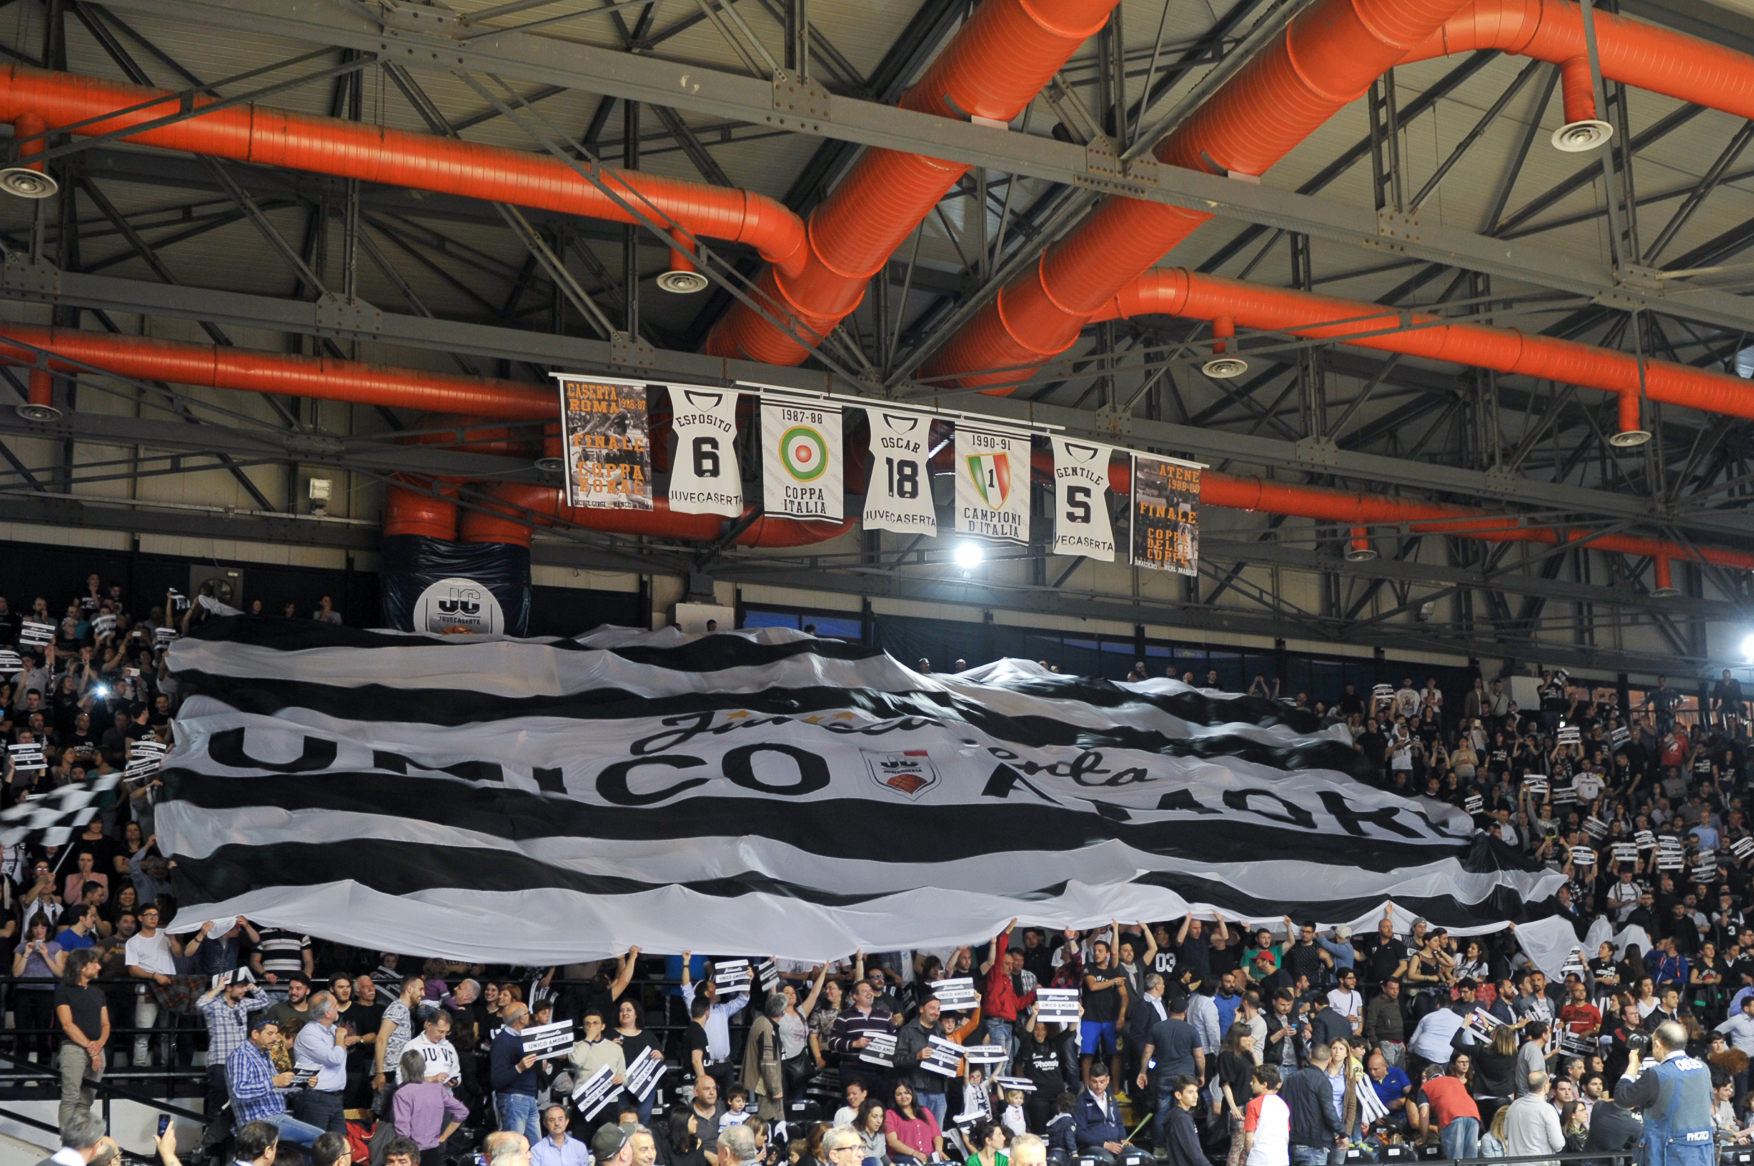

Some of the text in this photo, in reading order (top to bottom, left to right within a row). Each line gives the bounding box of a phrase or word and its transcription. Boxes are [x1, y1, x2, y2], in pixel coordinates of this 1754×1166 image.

[567, 383, 618, 400] CASERTA
[569, 399, 619, 414] ROMA
[675, 414, 732, 433] ESPOSITO
[781, 408, 823, 425] 1987-88
[573, 433, 645, 452] FINALE
[881, 437, 921, 453] OSCAR
[971, 434, 1011, 451] 1990-91
[692, 436, 720, 479] 6
[578, 461, 645, 480] COPPA
[885, 456, 919, 499] 18
[987, 468, 995, 489] 1
[1056, 466, 1104, 486] GENTILE
[1159, 464, 1200, 483] ATENE
[579, 477, 645, 496] KORAC
[785, 485, 824, 501] COPPA
[783, 499, 827, 515] ITALIA
[1066, 485, 1092, 524] 5
[1139, 501, 1197, 525] FINALE
[863, 509, 937, 528] JUVECASERTA
[964, 507, 1022, 526] CAMPIONI
[968, 521, 1020, 538] D'ITALIA
[1147, 527, 1189, 544] COPPA
[1147, 539, 1190, 556] DELLE
[1147, 549, 1189, 565] COPPE
[438, 587, 481, 615] JC
[438, 616, 481, 625] JUVECASERTA
[1727, 925, 1736, 936] 3
[1155, 952, 1177, 973] 03
[528, 1040, 548, 1050] UNICO
[548, 1035, 569, 1046] AMORE
[632, 1074, 646, 1089] UNICO
[582, 1080, 613, 1108] UNICO AMOR
[1686, 1131, 1709, 1142] PHOTO
